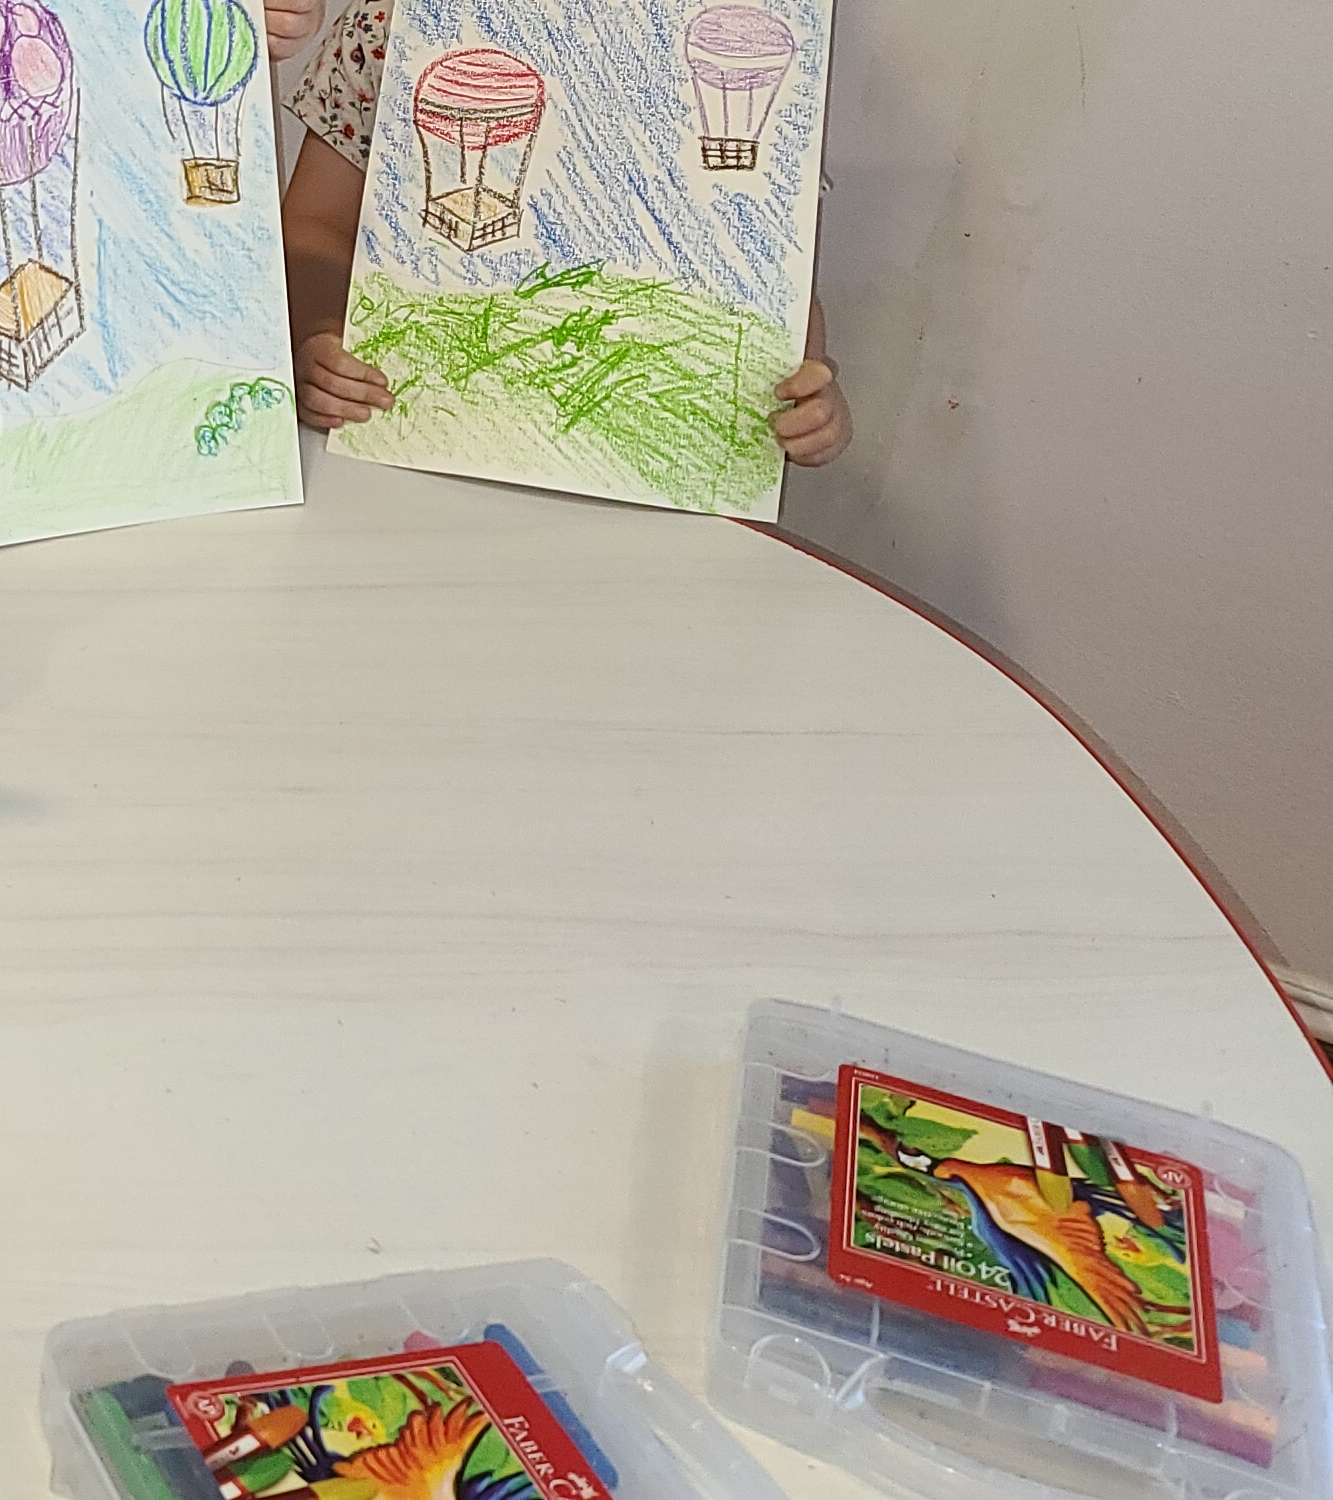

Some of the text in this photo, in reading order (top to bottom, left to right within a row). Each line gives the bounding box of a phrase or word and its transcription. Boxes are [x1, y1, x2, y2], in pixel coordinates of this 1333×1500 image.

[865, 1231, 936, 1266] Pastels
[942, 1255, 976, 1277] Oil
[977, 1260, 1013, 1295] 24
